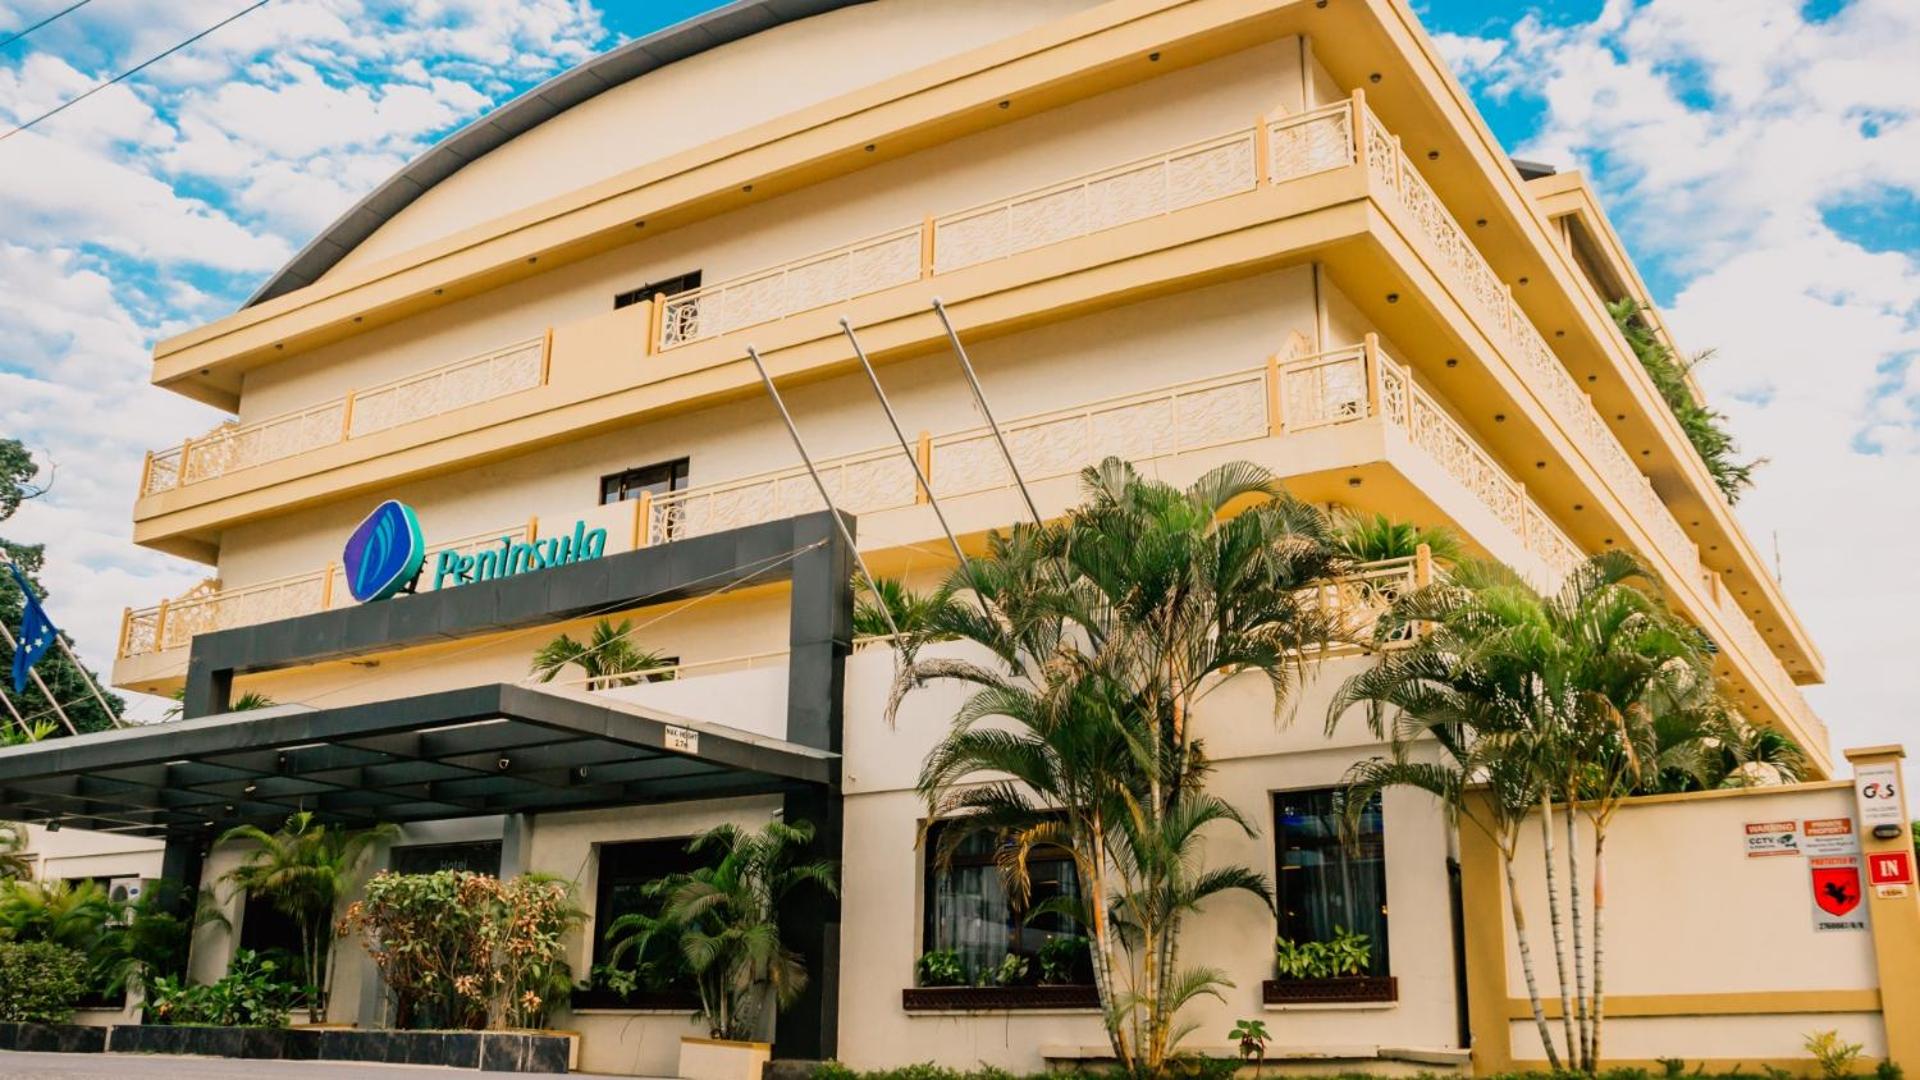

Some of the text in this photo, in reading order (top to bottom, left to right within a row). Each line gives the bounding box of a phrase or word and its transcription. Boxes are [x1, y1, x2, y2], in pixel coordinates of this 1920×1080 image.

[433, 520, 607, 590] Peninsula
[1748, 823, 1794, 834] WARNING
[1808, 826, 1849, 835] PROPERTY
[1750, 837, 1773, 846] CCTV
[1880, 860, 1899, 877] IN
